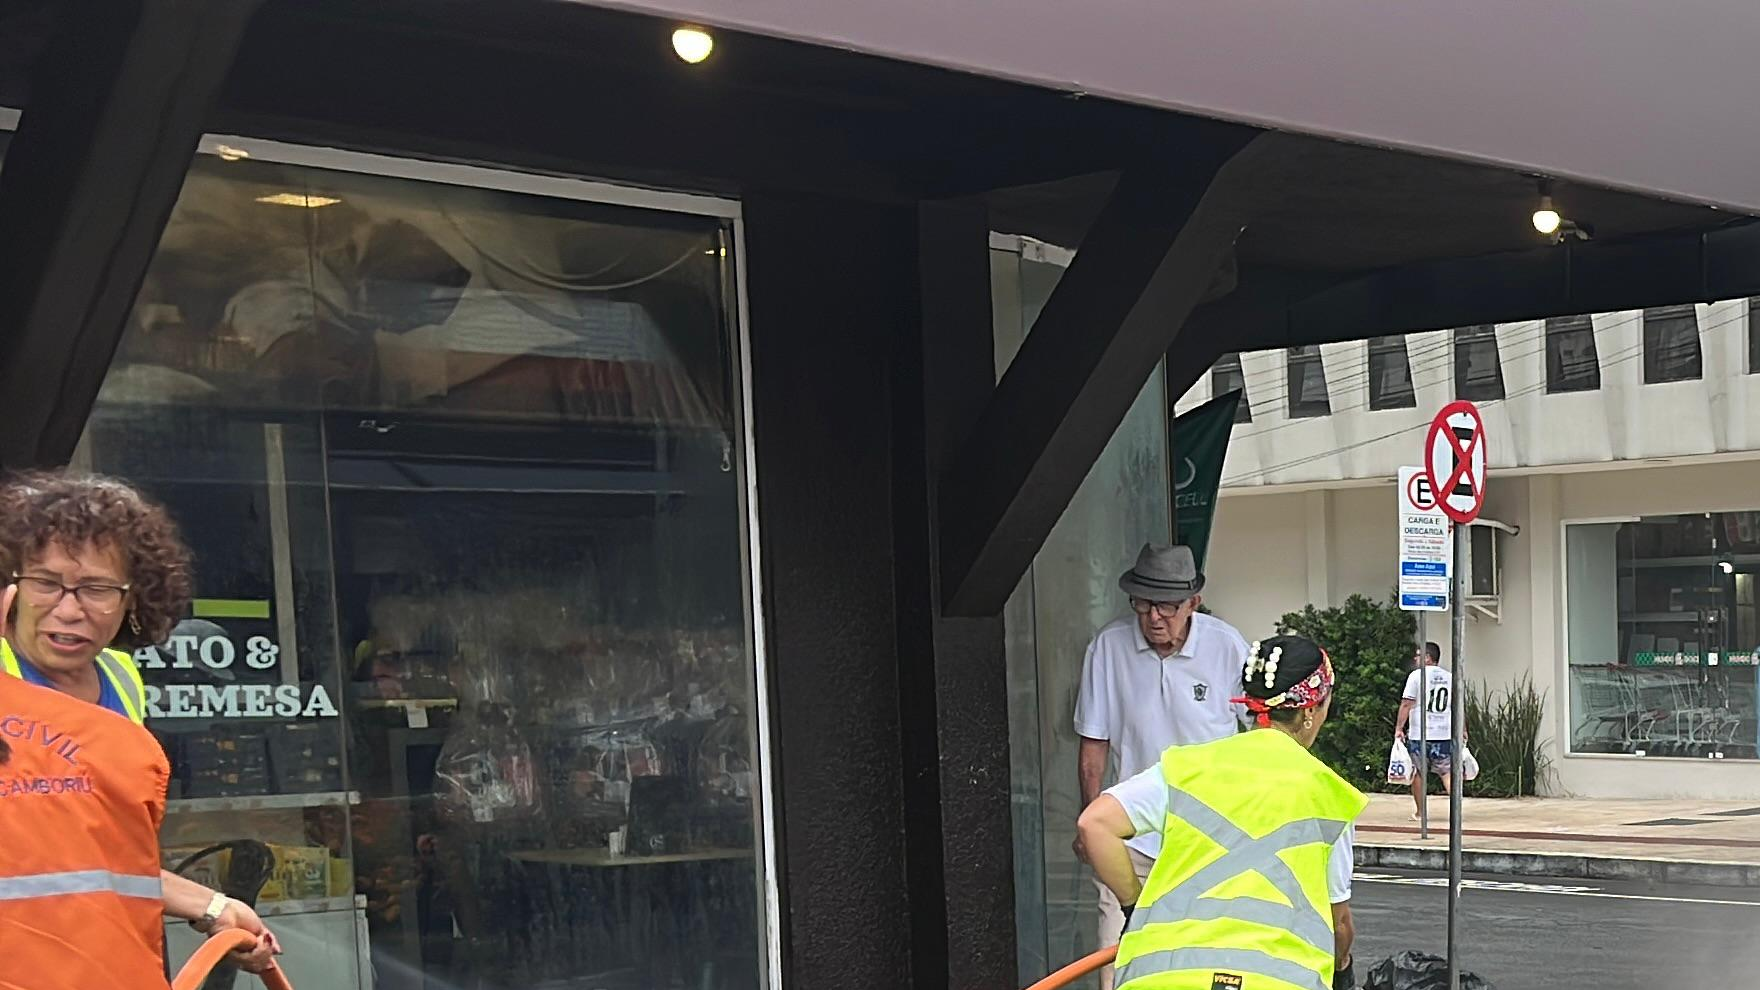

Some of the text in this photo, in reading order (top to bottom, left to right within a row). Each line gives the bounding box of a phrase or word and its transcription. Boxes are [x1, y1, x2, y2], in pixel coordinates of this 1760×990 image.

[246, 635, 279, 669] &
[1427, 687, 1449, 713] 10
[0, 715, 81, 766] CIVIL
